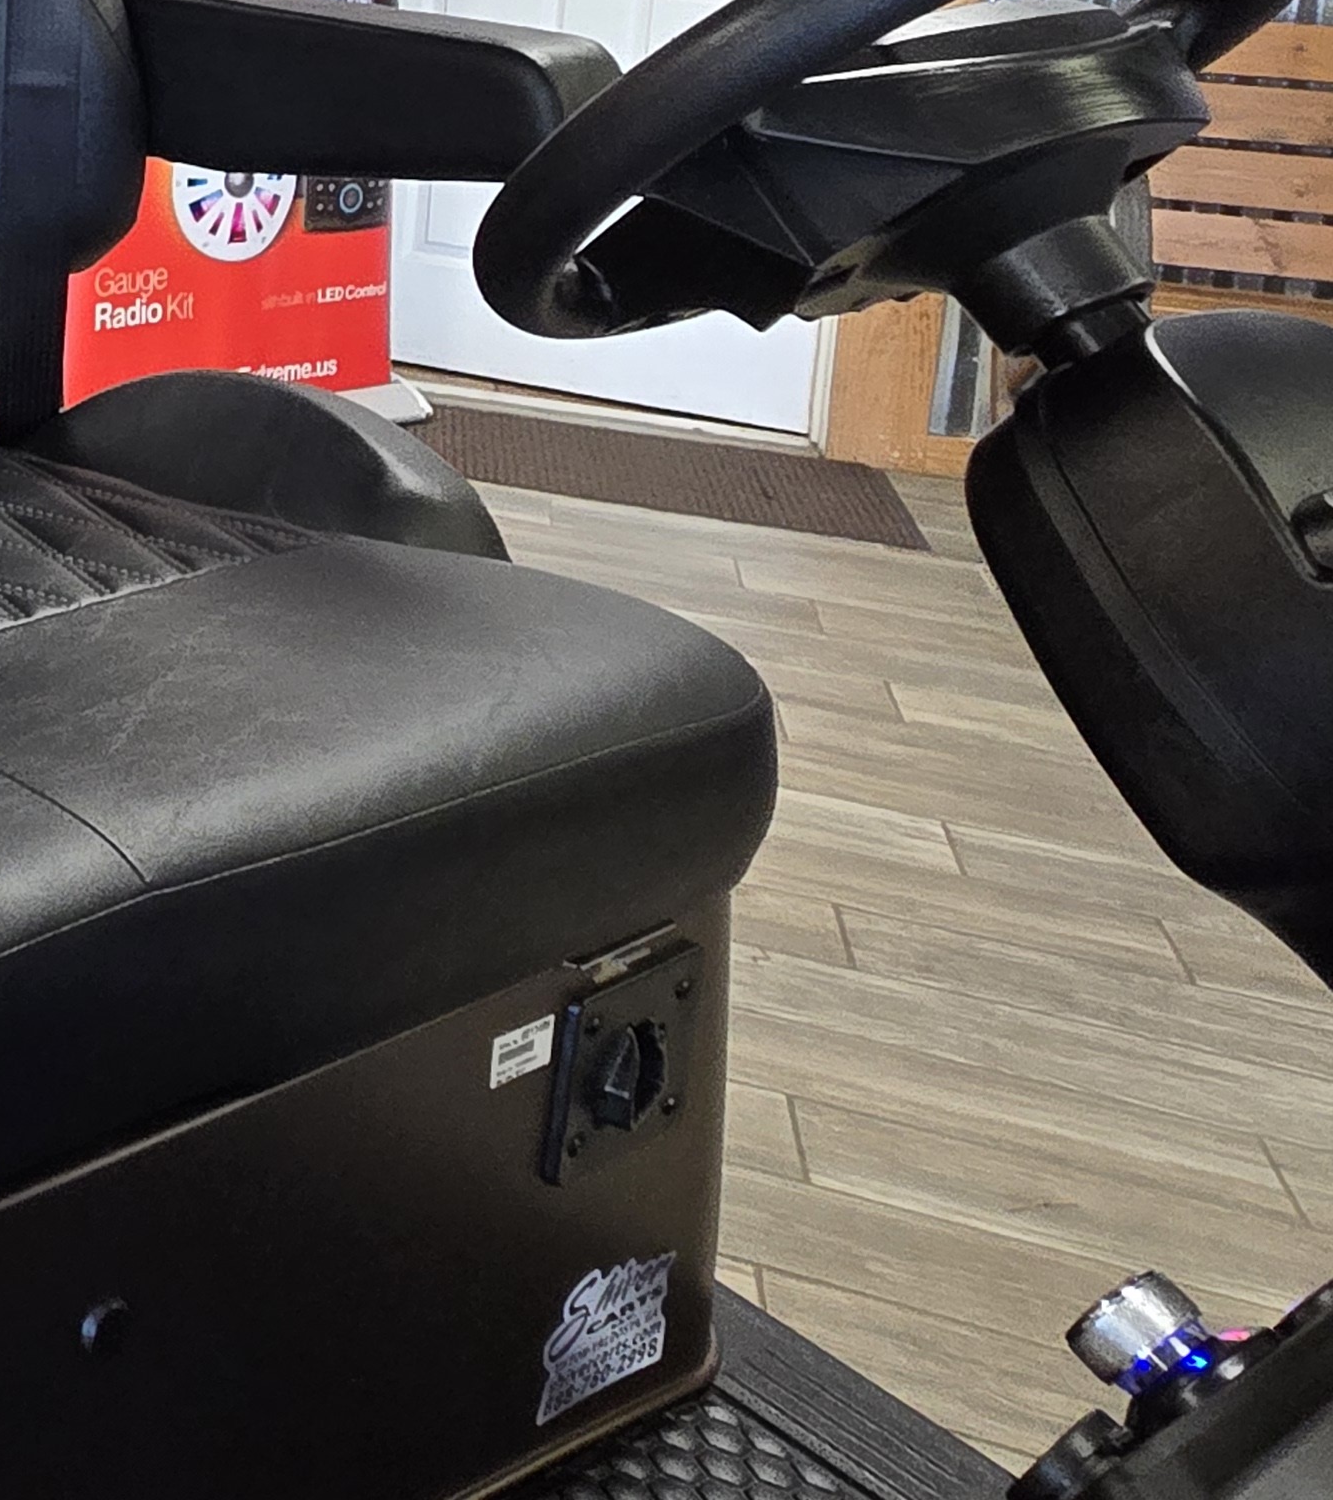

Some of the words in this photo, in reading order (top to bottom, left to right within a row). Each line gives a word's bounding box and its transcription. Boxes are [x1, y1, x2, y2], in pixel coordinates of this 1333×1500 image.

[94, 267, 168, 303] Gauge
[317, 285, 344, 304] LED
[345, 280, 387, 300] Control
[94, 297, 162, 332] Radio
[166, 292, 195, 322] Kit
